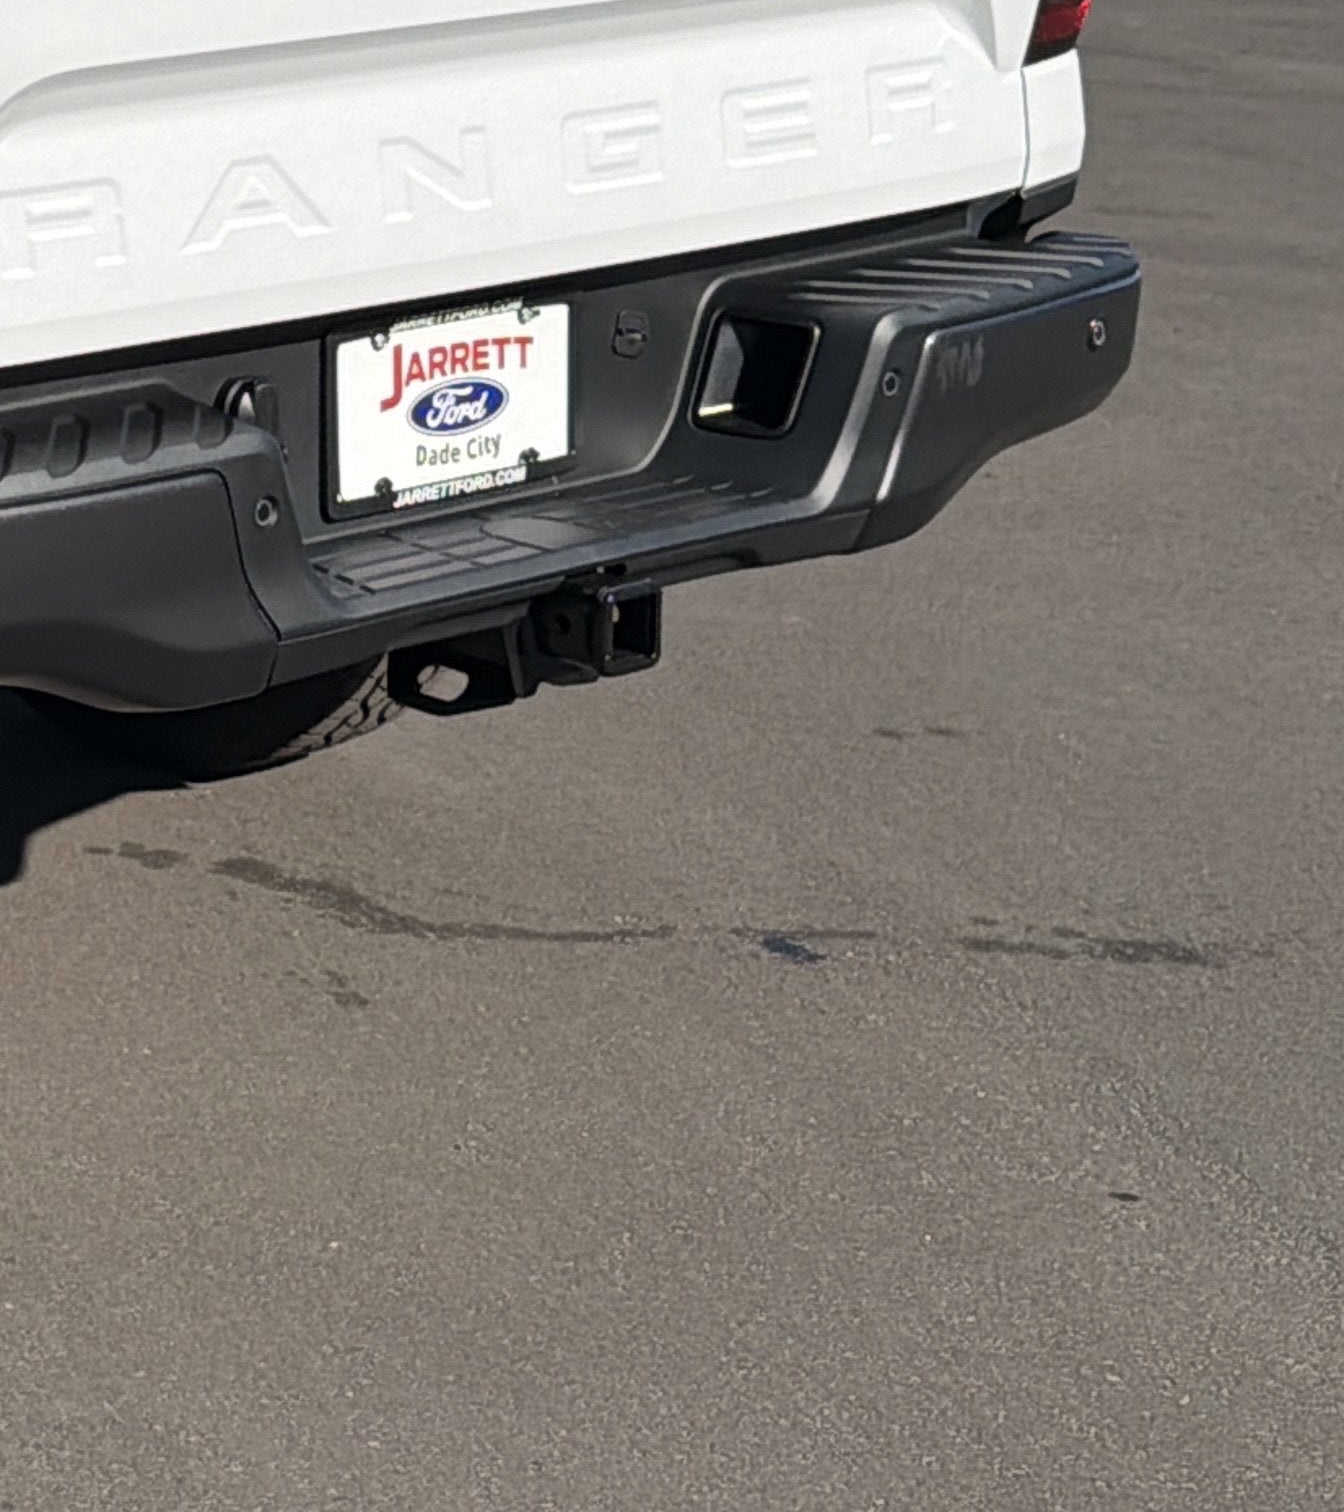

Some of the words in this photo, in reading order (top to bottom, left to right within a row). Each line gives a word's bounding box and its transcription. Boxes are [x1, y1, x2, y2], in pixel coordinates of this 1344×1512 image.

[379, 335, 534, 413] JARRETT
[425, 385, 489, 429] Ford
[416, 444, 461, 466] Dade
[466, 433, 502, 460] City
[393, 466, 527, 508] JARRETTFORD.COM
